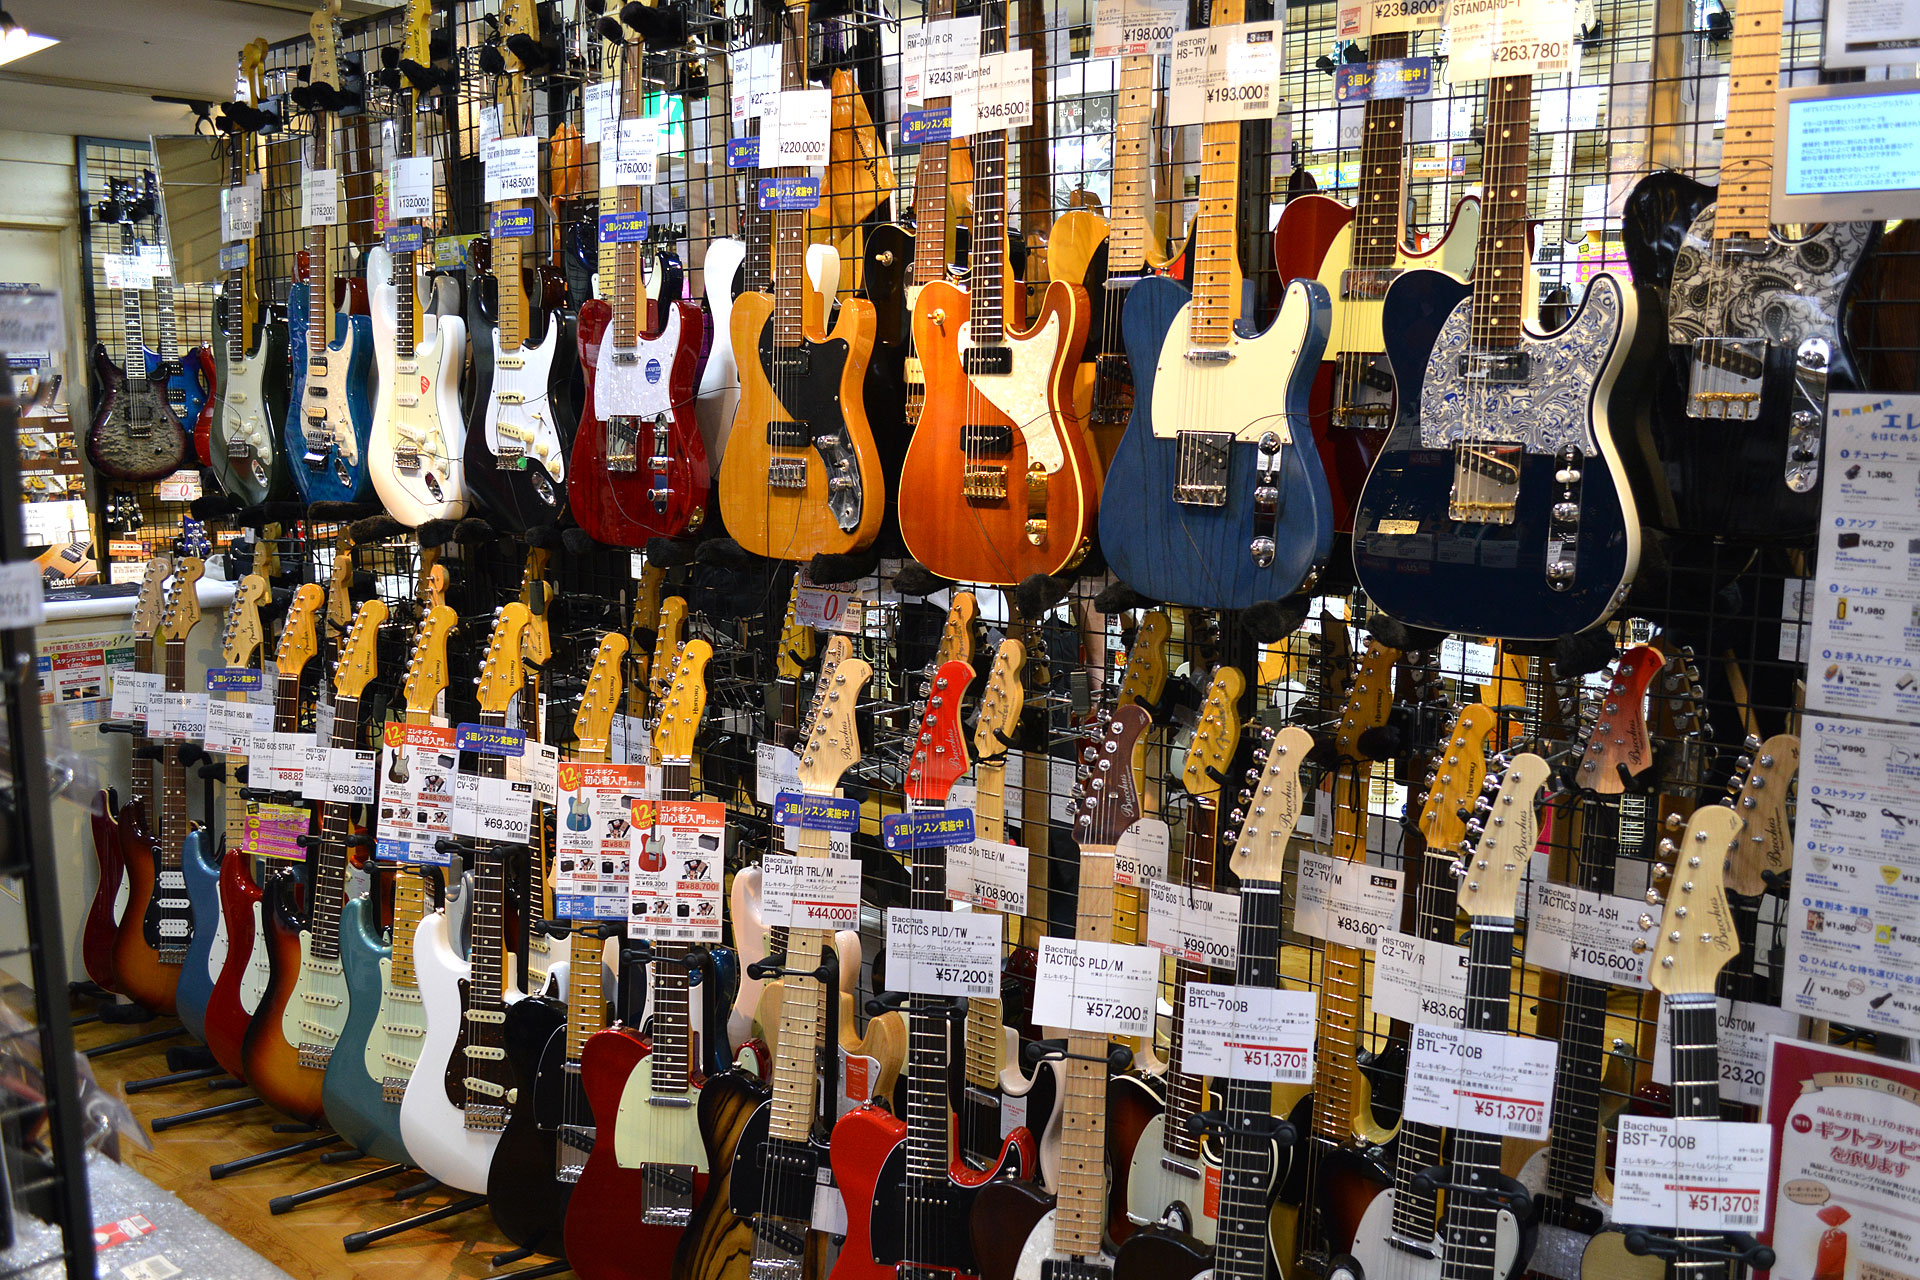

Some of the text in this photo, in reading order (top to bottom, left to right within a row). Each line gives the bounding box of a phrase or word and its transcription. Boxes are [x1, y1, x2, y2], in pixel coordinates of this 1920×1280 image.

[1375, 1, 1437, 19] ¥239,800
[942, 33, 953, 43] CR
[1124, 26, 1173, 42] ¥198,000
[1177, 37, 1207, 47] HISTORY
[1177, 44, 1217, 59] HS-TV/M
[1491, 42, 1561, 63] ¥263,780
[1207, 85, 1263, 103] ¥193,000
[978, 101, 1024, 119] ¥346,500
[780, 142, 821, 153] ¥220,000
[616, 162, 648, 174] ¥176,000
[502, 177, 531, 189] ¥148,500
[399, 198, 426, 208] ¥132,000
[210, 708, 223, 717] PLAYER
[172, 723, 203, 732] ¥76,230
[1828, 725, 1862, 735] スタンド
[253, 742, 265, 750] TRAD
[278, 743, 295, 751] STRAT
[465, 732, 523, 747] 3回レッスン実施中！
[305, 753, 326, 762] CV-SV
[279, 772, 303, 780] ¥88,82
[584, 775, 627, 786] 初心者入門
[333, 784, 368, 796] ¥69,300
[457, 781, 479, 791] CV-SV
[1824, 788, 1866, 800] ストラップ
[784, 802, 856, 820] 3回レッスン実施中！
[1278, 780, 1292, 829] Bacchus
[660, 813, 705, 824] 初心者入門
[1836, 808, 1866, 818] ¥1,320
[485, 818, 523, 831] ¥69,300
[894, 819, 971, 836] 3回レッスン実施中！
[1513, 810, 1529, 864] Bacchus
[968, 846, 979, 857] 50s
[981, 849, 1005, 862] TELE/M
[1819, 844, 1844, 853] ピック
[764, 864, 833, 878] G-PLAYER TRL/M
[1115, 859, 1156, 877] ¥89,100
[1303, 859, 1332, 870] HISTORY
[1832, 864, 1855, 873] ¥110
[1303, 868, 1342, 885] CZ-TV/M
[685, 882, 716, 891] ¥88,700
[974, 883, 1019, 904] ¥108,900
[1151, 882, 1172, 892] Fender
[1539, 885, 1571, 899] Bacchus
[1150, 890, 1164, 904] TRAD
[807, 907, 851, 921] ¥44,000
[1538, 894, 1619, 921] TACTICS DX-ASH
[892, 915, 923, 924] Bacchus
[1826, 921, 1856, 932] ¥1,980
[892, 924, 968, 938] TACTICS PLD/TW
[1045, 945, 1076, 955] Bacchus
[1184, 937, 1229, 957] ¥99,000
[1382, 936, 1415, 950] HISTORY
[1044, 953, 1123, 971] TACTICS PLD/M
[1382, 945, 1425, 965] CZ-TV/R
[1571, 945, 1636, 971] ¥105,600
[936, 968, 987, 984] ¥57,200
[1189, 987, 1226, 998] Bacchus
[1087, 1002, 1141, 1021] ¥57,200
[1189, 997, 1248, 1013] BTL-700B
[1422, 999, 1465, 1019] ¥83,60
[1718, 1015, 1755, 1033] CUSTOM
[1418, 1028, 1458, 1042] Bacchus
[1416, 1038, 1483, 1059] BTL-700B
[1245, 1051, 1301, 1068] ¥51,370
[1722, 1064, 1764, 1086] 23,20
[1835, 1075, 1879, 1088] MUSIC
[1475, 1100, 1536, 1122] ¥51,370
[1624, 1121, 1668, 1133] Bacchus
[1623, 1133, 1696, 1149] BST-700B
[1689, 1194, 1752, 1213] ¥51,370
